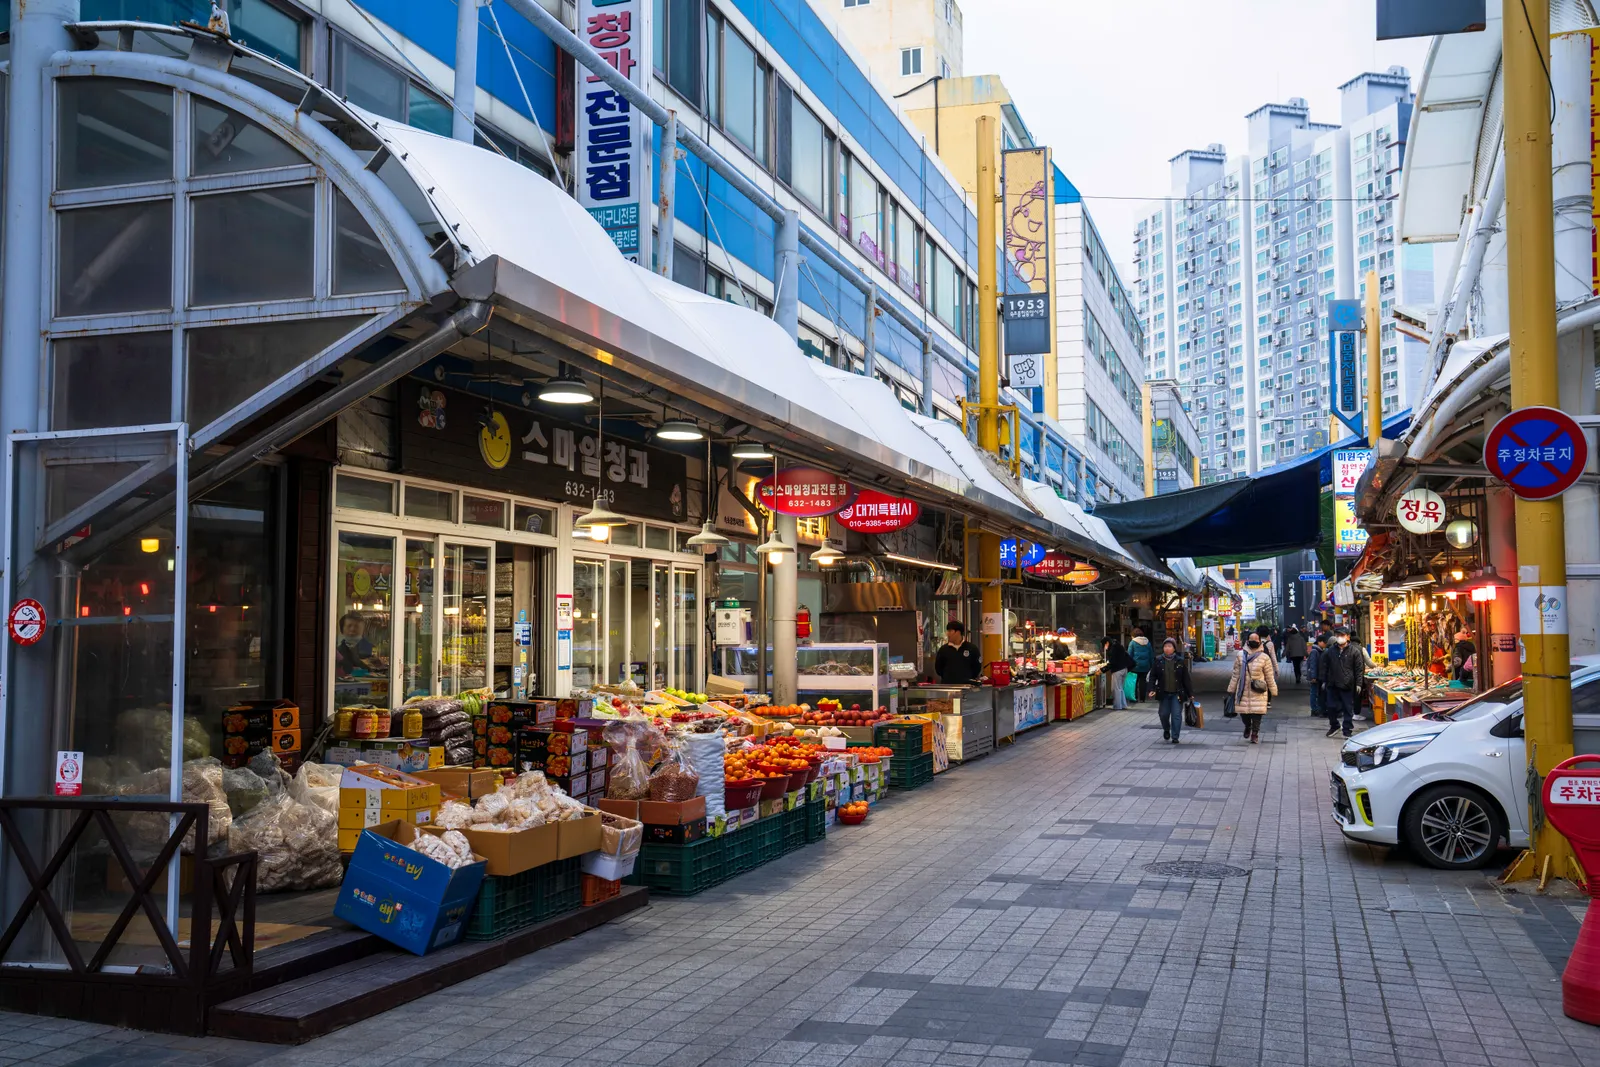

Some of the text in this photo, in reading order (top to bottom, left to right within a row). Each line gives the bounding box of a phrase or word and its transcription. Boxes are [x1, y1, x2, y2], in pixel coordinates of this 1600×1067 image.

[1009, 299, 1045, 310] 1953
[521, 420, 649, 488] 스마일청과
[1497, 446, 1572, 463] 주정차금지
[565, 480, 615, 503] 632-1483
[776, 483, 847, 496] 스마일청과전문점
[788, 499, 831, 507] 632-1483
[856, 502, 912, 517] 대게특별시
[1399, 499, 1442, 523] 정육
[849, 519, 901, 527] 010-9385-6591
